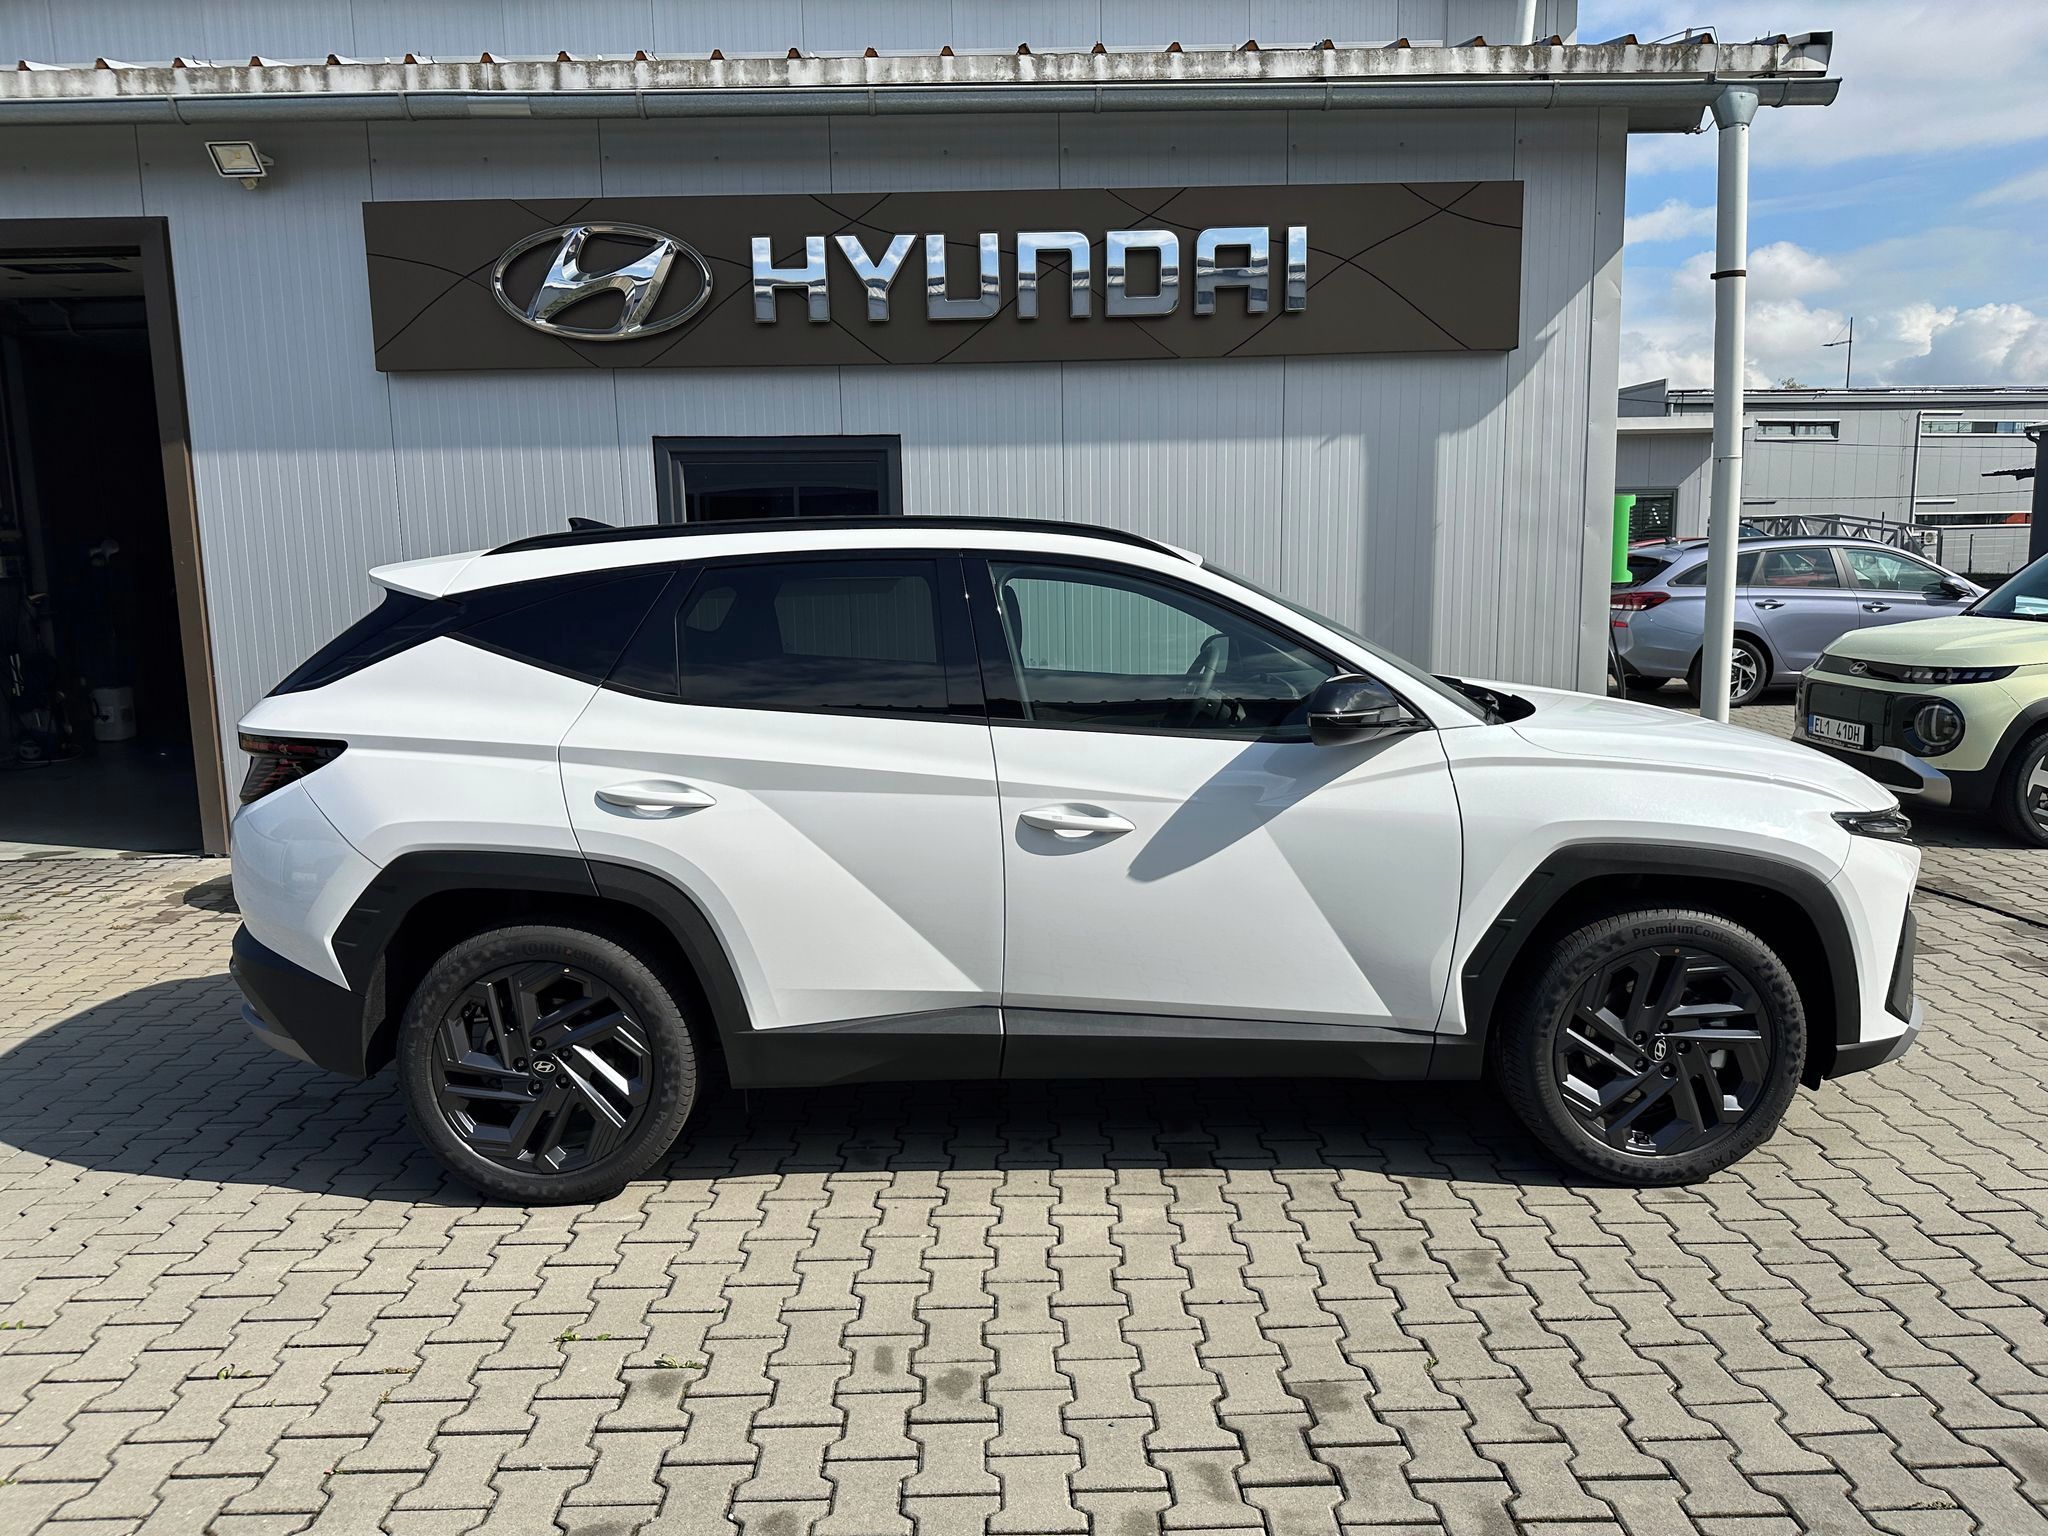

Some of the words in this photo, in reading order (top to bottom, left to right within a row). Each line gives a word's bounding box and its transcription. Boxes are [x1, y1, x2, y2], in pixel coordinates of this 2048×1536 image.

[751, 225, 1308, 323] HYUNDAI
[1815, 717, 1831, 736] EL1
[1836, 722, 1861, 743] 41DH
